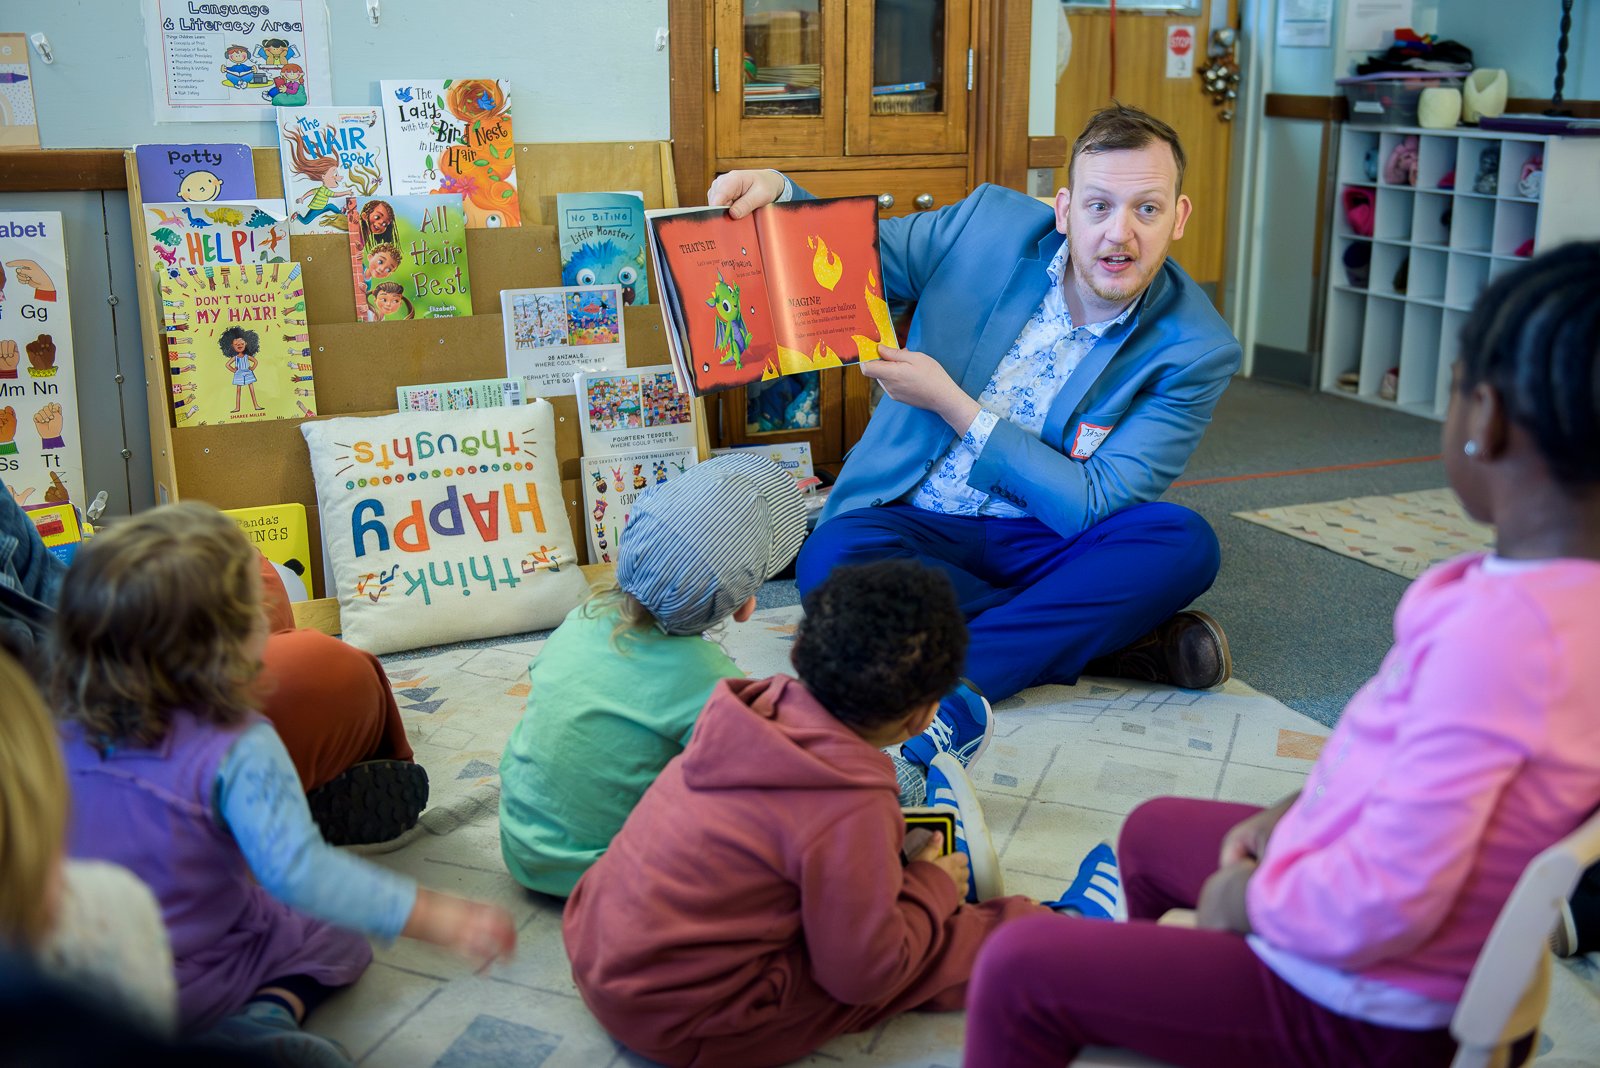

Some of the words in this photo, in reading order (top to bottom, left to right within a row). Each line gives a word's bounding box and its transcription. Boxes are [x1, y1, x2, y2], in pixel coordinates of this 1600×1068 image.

[188, 1, 270, 18] Language
[163, 17, 175, 30] &
[179, 17, 255, 35] Literacy
[261, 19, 303, 32] Area
[1169, 36, 1192, 48] STOP
[415, 88, 432, 100] The
[398, 102, 442, 123] Lady
[297, 116, 320, 131] The
[401, 123, 418, 133] with
[418, 122, 430, 130] the
[436, 120, 472, 147] Bird
[475, 122, 508, 146] Nest
[302, 127, 367, 159] HAIR
[420, 141, 428, 151] in
[429, 142, 443, 153] Her
[446, 146, 477, 175] Hair
[419, 205, 449, 233] All
[570, 227, 594, 245] Little
[597, 225, 636, 241] Monster!
[186, 231, 255, 266] HELP!
[410, 239, 462, 266] Hair
[679, 241, 707, 254] THAT'S
[706, 240, 717, 250] IT!
[411, 266, 467, 298] Best
[195, 295, 231, 306] DON'T
[236, 293, 275, 304] TOUCH
[21, 304, 48, 322] Gg
[196, 308, 221, 324] MY
[228, 306, 277, 322] HAIR!
[821, 305, 836, 314] water
[837, 303, 857, 311] balloon
[523, 373, 549, 381] PERHAPS
[33, 381, 58, 395] Nn
[612, 434, 645, 442] FOURTEEN
[353, 429, 520, 470] thoughts
[41, 454, 60, 468] Tt
[236, 516, 279, 529] Panda's
[403, 554, 521, 605] think
